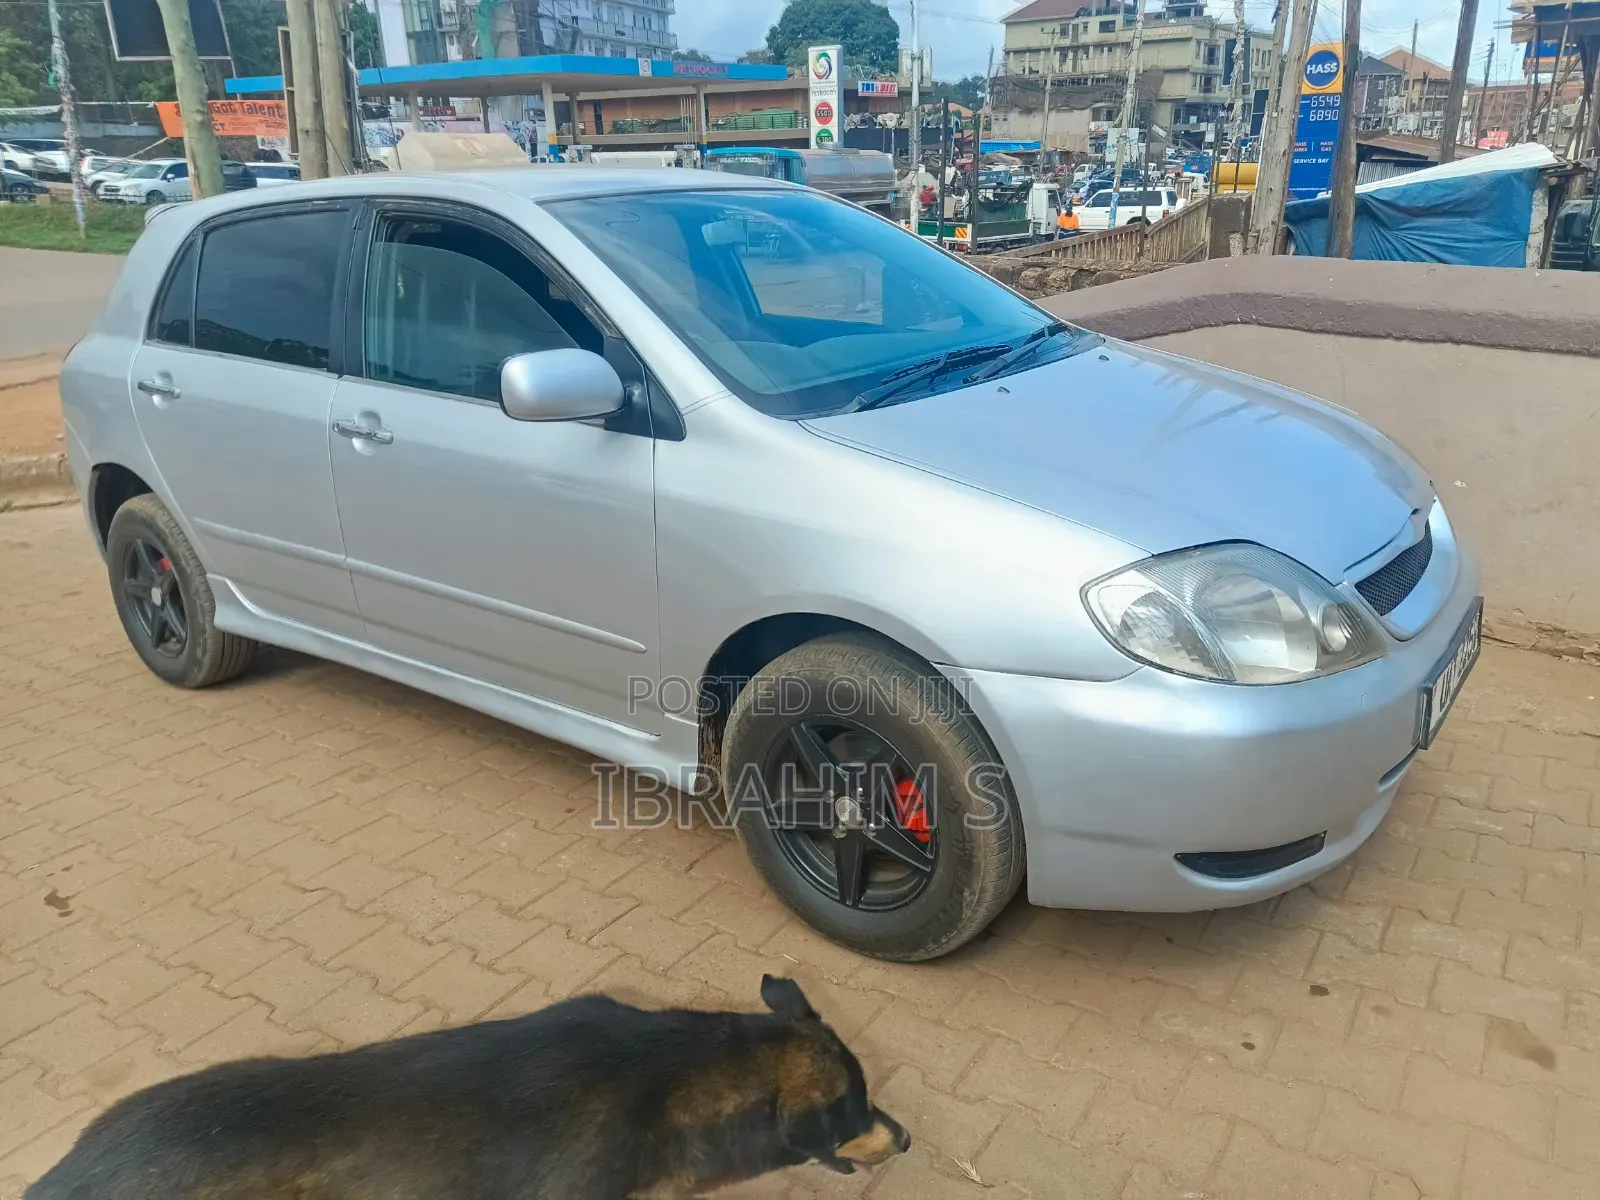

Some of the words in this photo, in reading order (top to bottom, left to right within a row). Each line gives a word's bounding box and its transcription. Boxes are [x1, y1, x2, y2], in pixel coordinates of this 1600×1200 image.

[1306, 62, 1338, 74] HASS
[1311, 95, 1341, 107] 6549
[211, 101, 237, 115] Got
[240, 103, 285, 121] Talent
[1309, 109, 1339, 121] 6890
